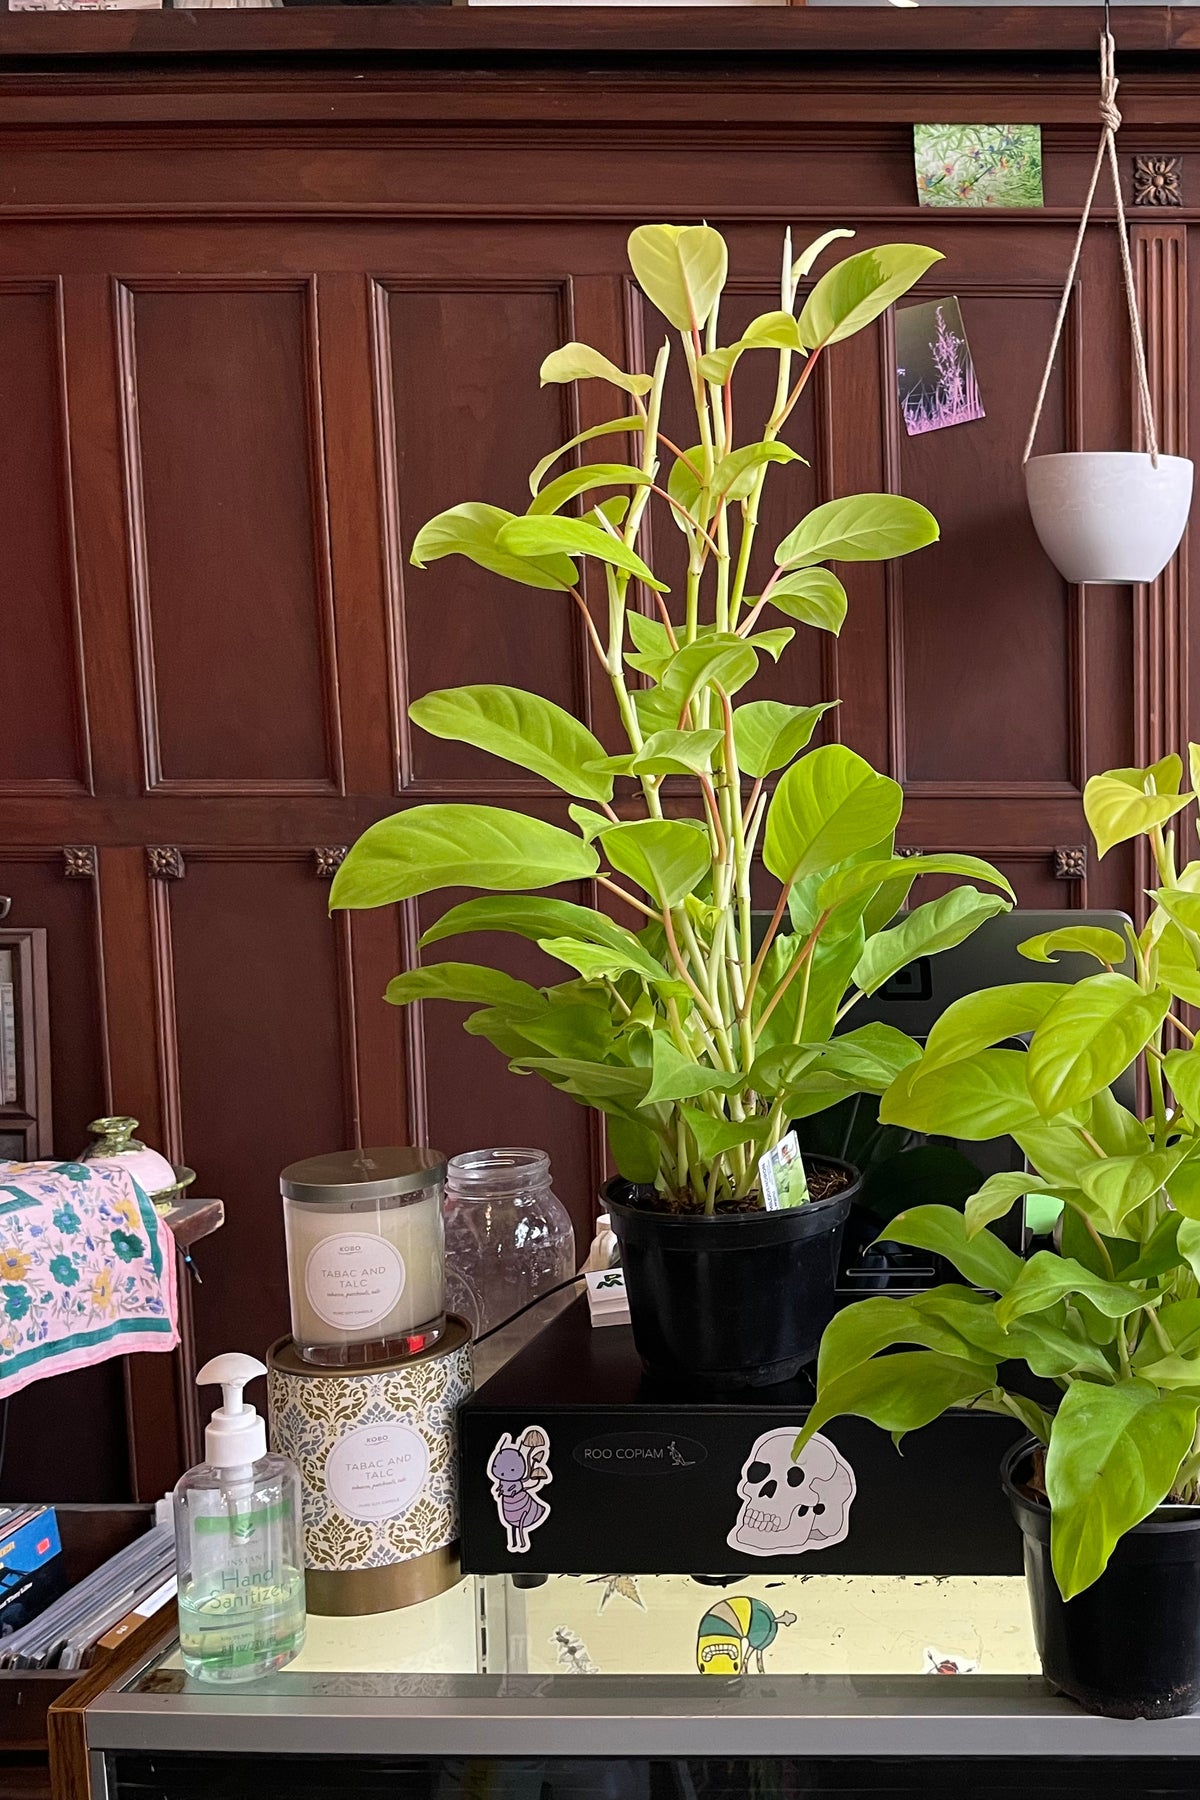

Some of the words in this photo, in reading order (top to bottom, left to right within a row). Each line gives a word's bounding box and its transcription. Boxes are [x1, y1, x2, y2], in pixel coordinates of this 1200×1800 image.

[321, 1269, 357, 1278] TABAC
[361, 1266, 386, 1276] AND
[339, 1279, 368, 1288] TALC
[366, 1435, 388, 1443] KOBO
[584, 1449, 612, 1459] ROO
[615, 1449, 663, 1459] COPIAM
[345, 1460, 383, 1471] TABAC
[387, 1454, 411, 1465] AND
[365, 1469, 393, 1479] TALC
[221, 1560, 274, 1590] Hand
[210, 1582, 284, 1609] Sanitizer
